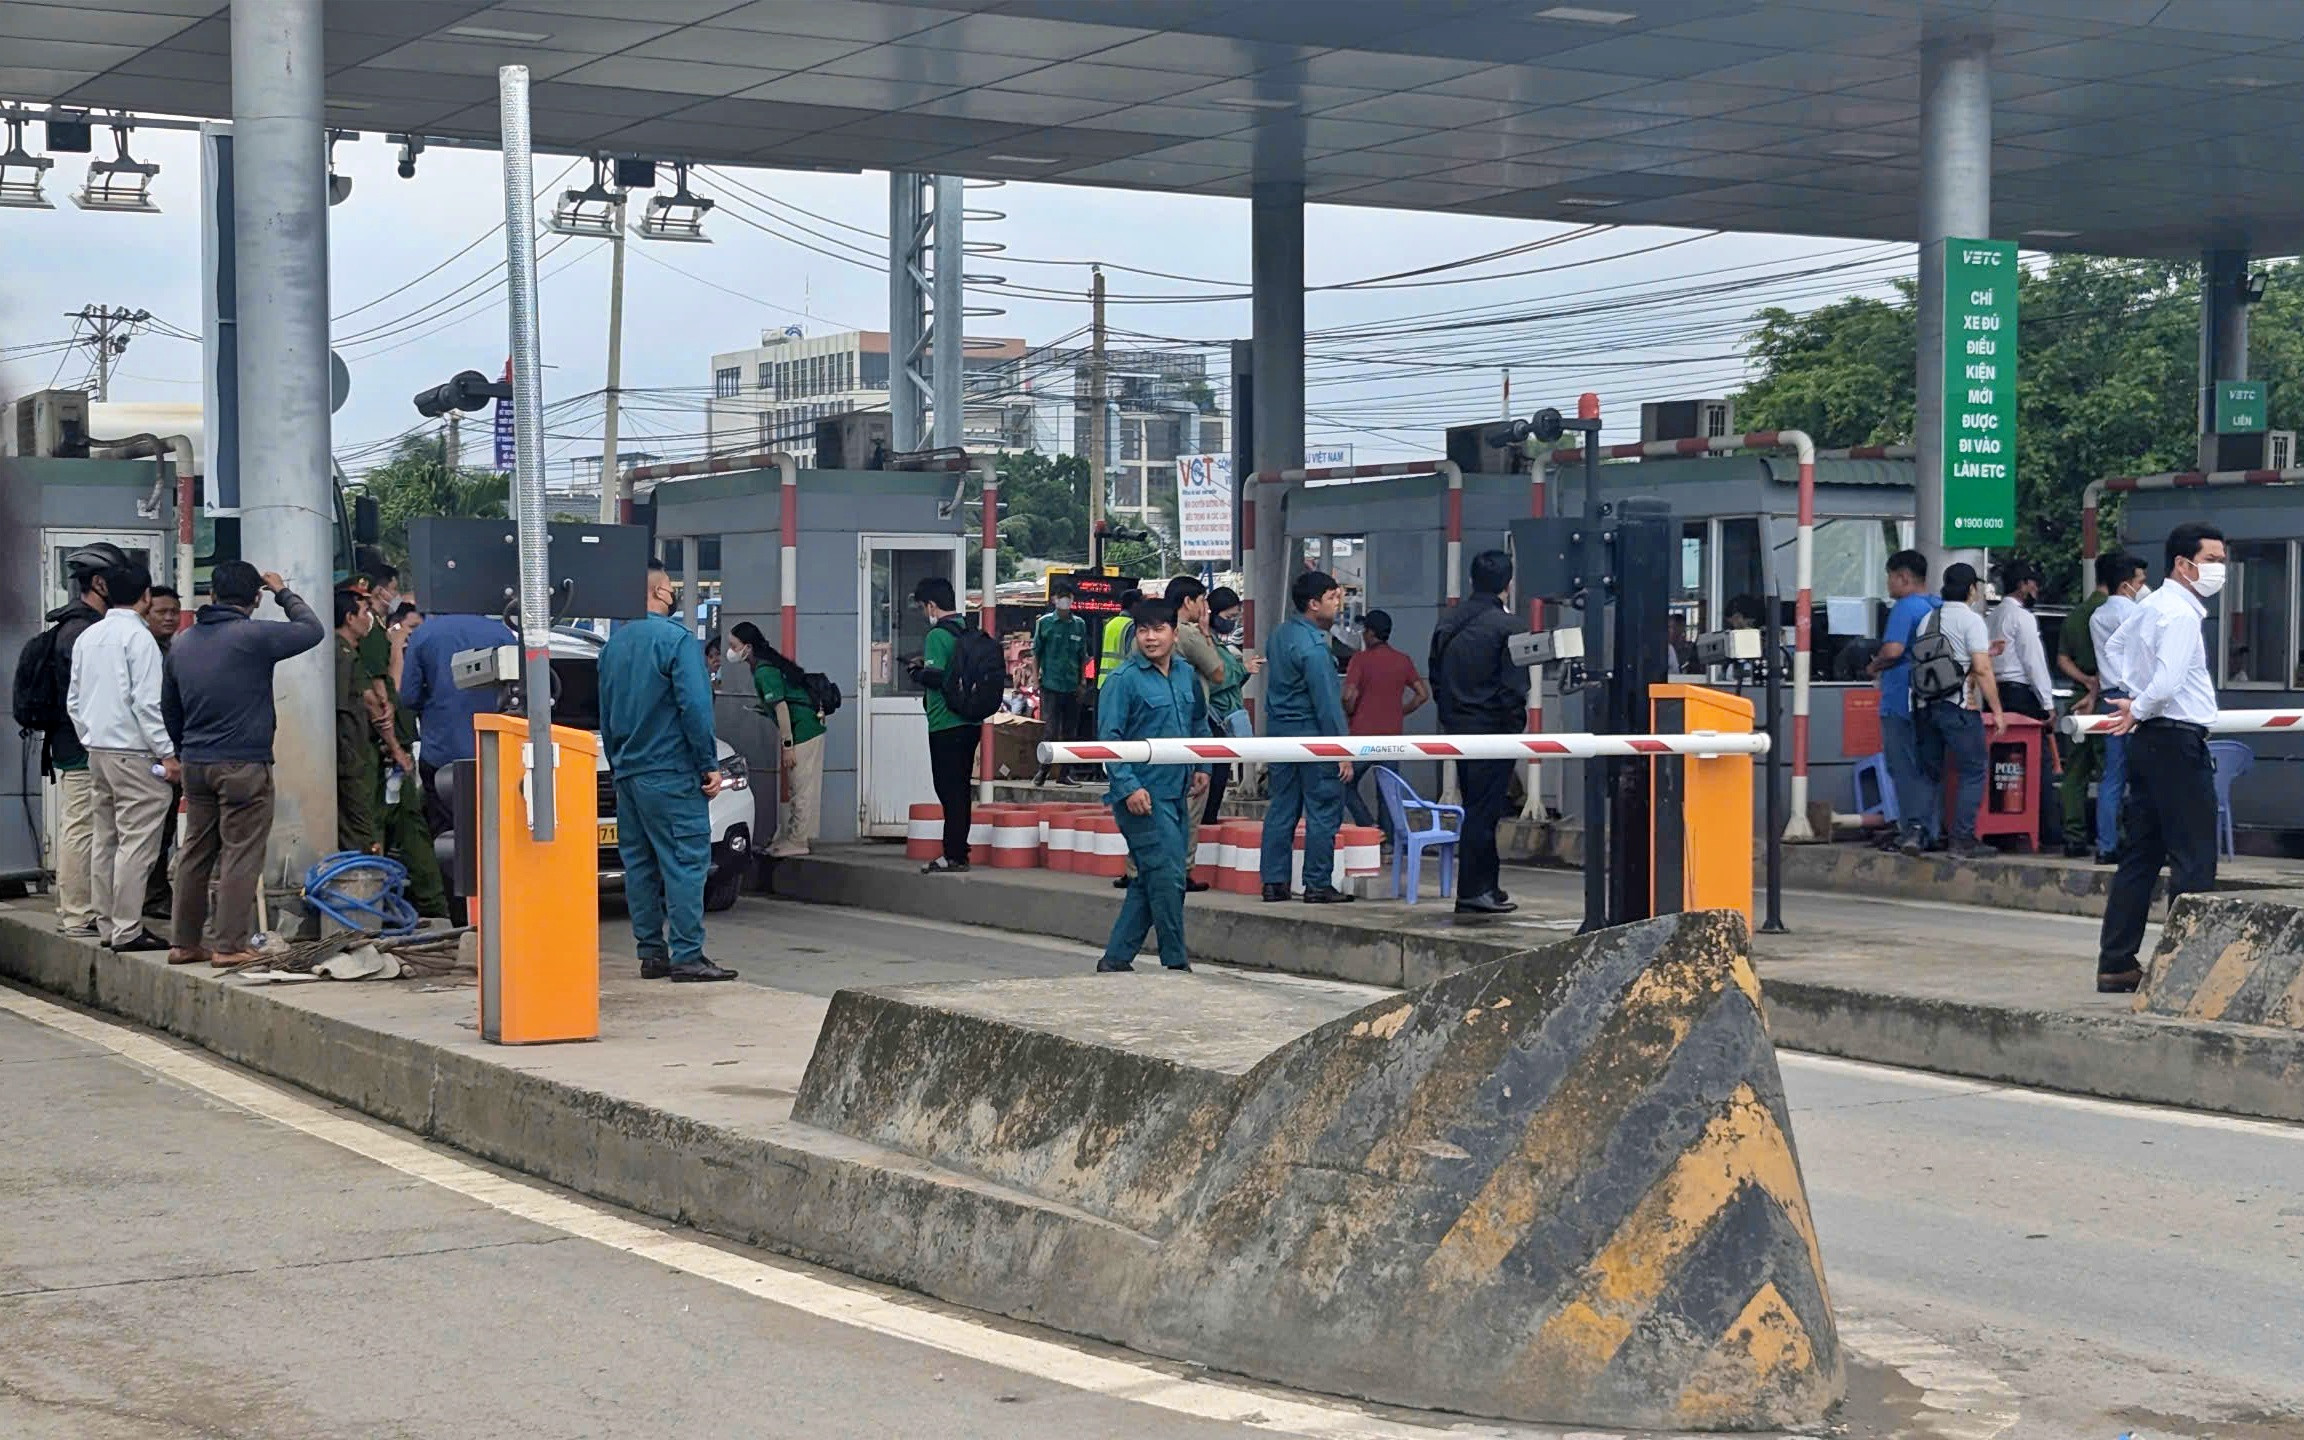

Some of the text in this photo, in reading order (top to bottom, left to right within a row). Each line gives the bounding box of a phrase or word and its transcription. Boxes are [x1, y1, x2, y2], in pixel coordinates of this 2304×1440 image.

[1963, 250, 2002, 266] VETC
[1963, 315, 1980, 330] XE
[1965, 362, 1996, 384] KIỆN
[1968, 387, 1993, 405] MỚI
[2229, 390, 2256, 400] VETC
[1961, 413, 1998, 433] ĐƯỢC
[1959, 435, 2001, 454] ĐI VÀO
[1953, 460, 2006, 479] LÀN ETC
[1963, 518, 2004, 529] 1900 6010
[600, 827, 619, 841] 71
